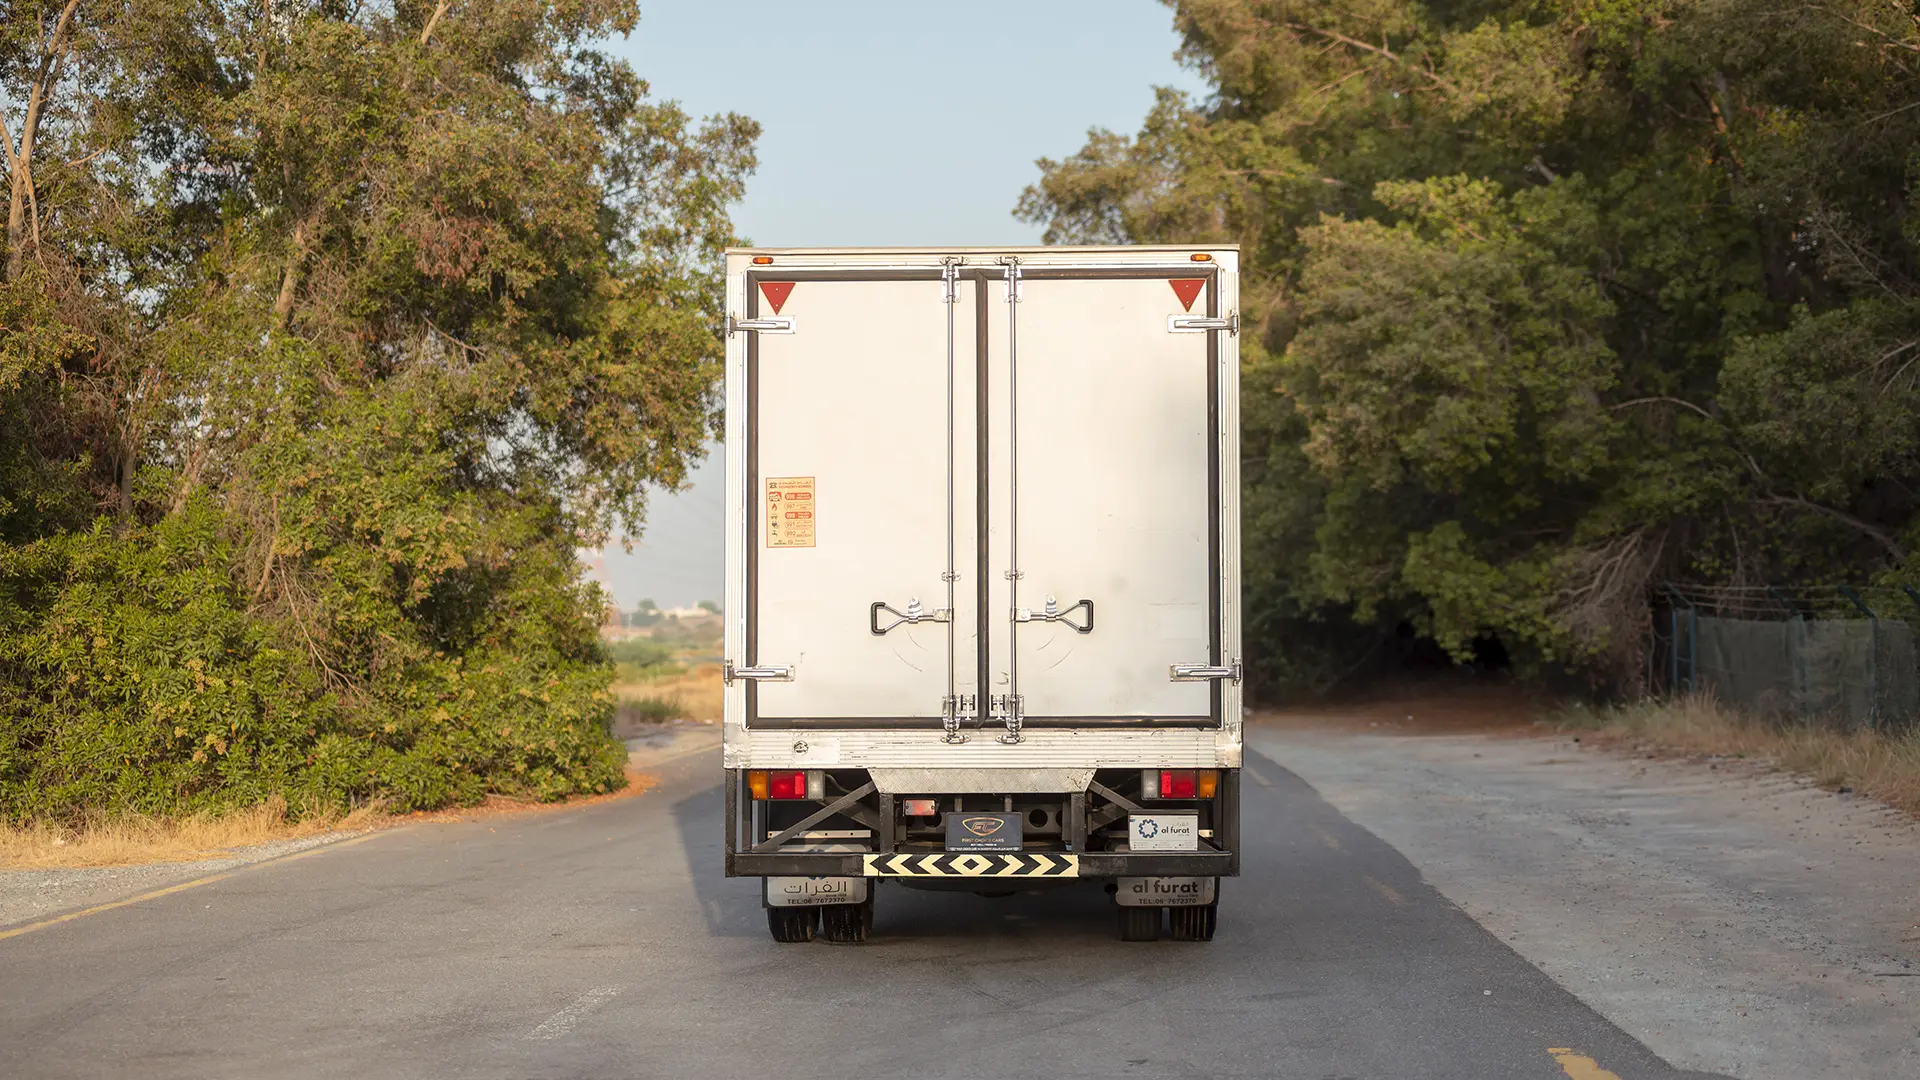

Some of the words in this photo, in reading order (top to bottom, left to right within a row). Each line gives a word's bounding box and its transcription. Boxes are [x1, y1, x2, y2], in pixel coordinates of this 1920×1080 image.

[784, 881, 846, 896] الفرات
[1133, 880, 1148, 893] al
[1154, 880, 1198, 893] furat
